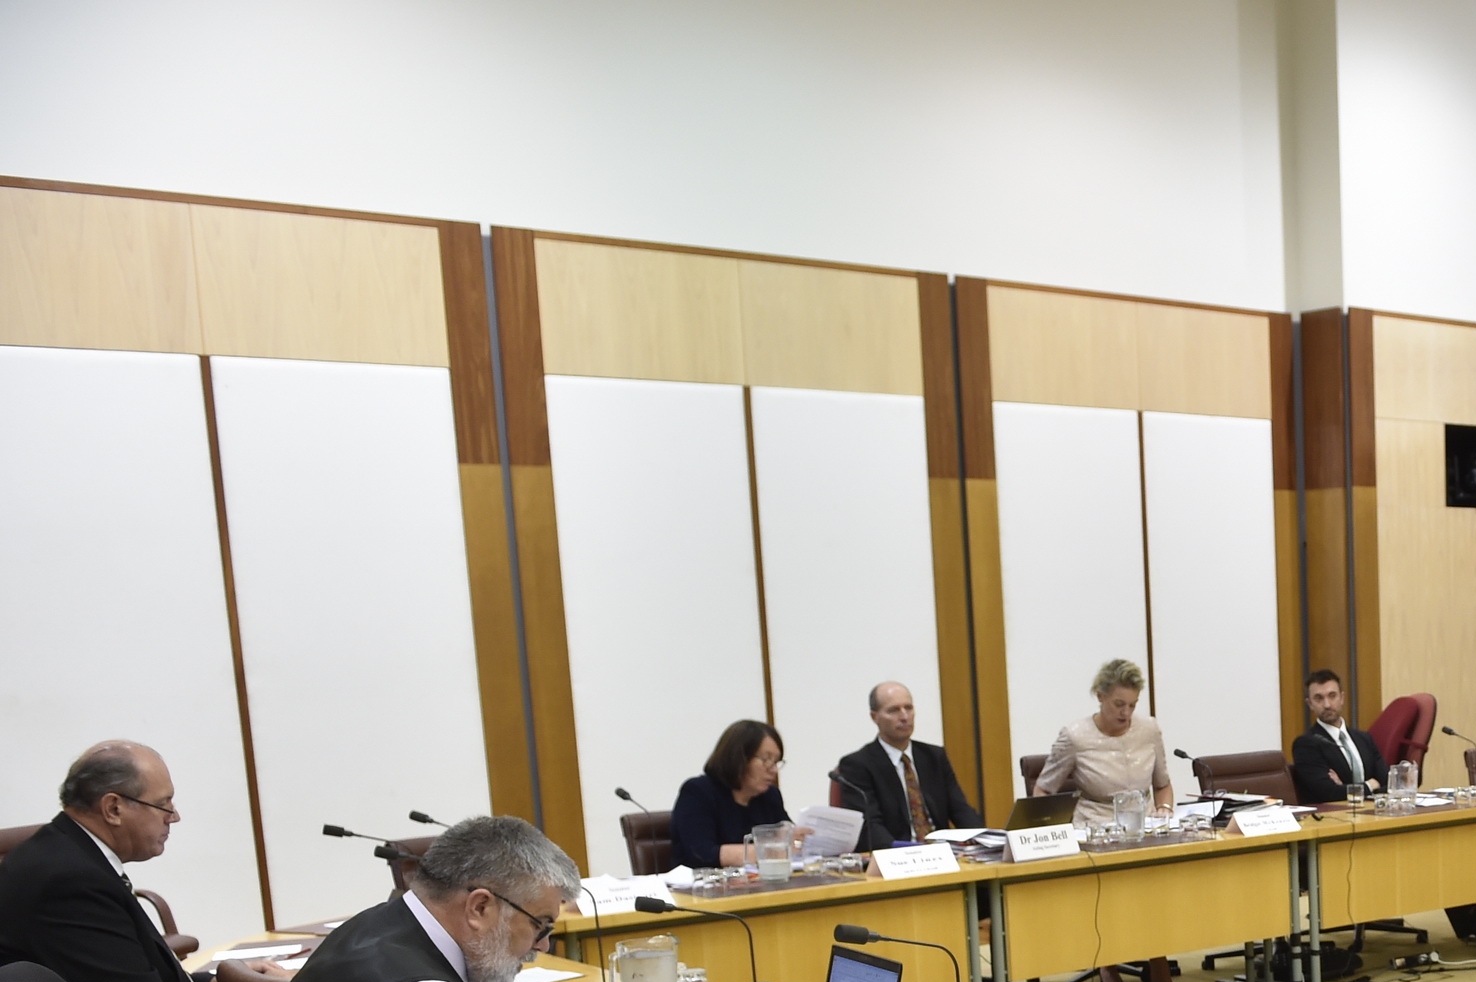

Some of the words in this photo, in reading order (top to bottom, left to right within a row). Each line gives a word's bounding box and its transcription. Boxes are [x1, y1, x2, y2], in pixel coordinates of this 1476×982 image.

[1018, 835, 1031, 845] Dr
[1033, 833, 1050, 844] Jon
[1050, 830, 1068, 841] Bell
